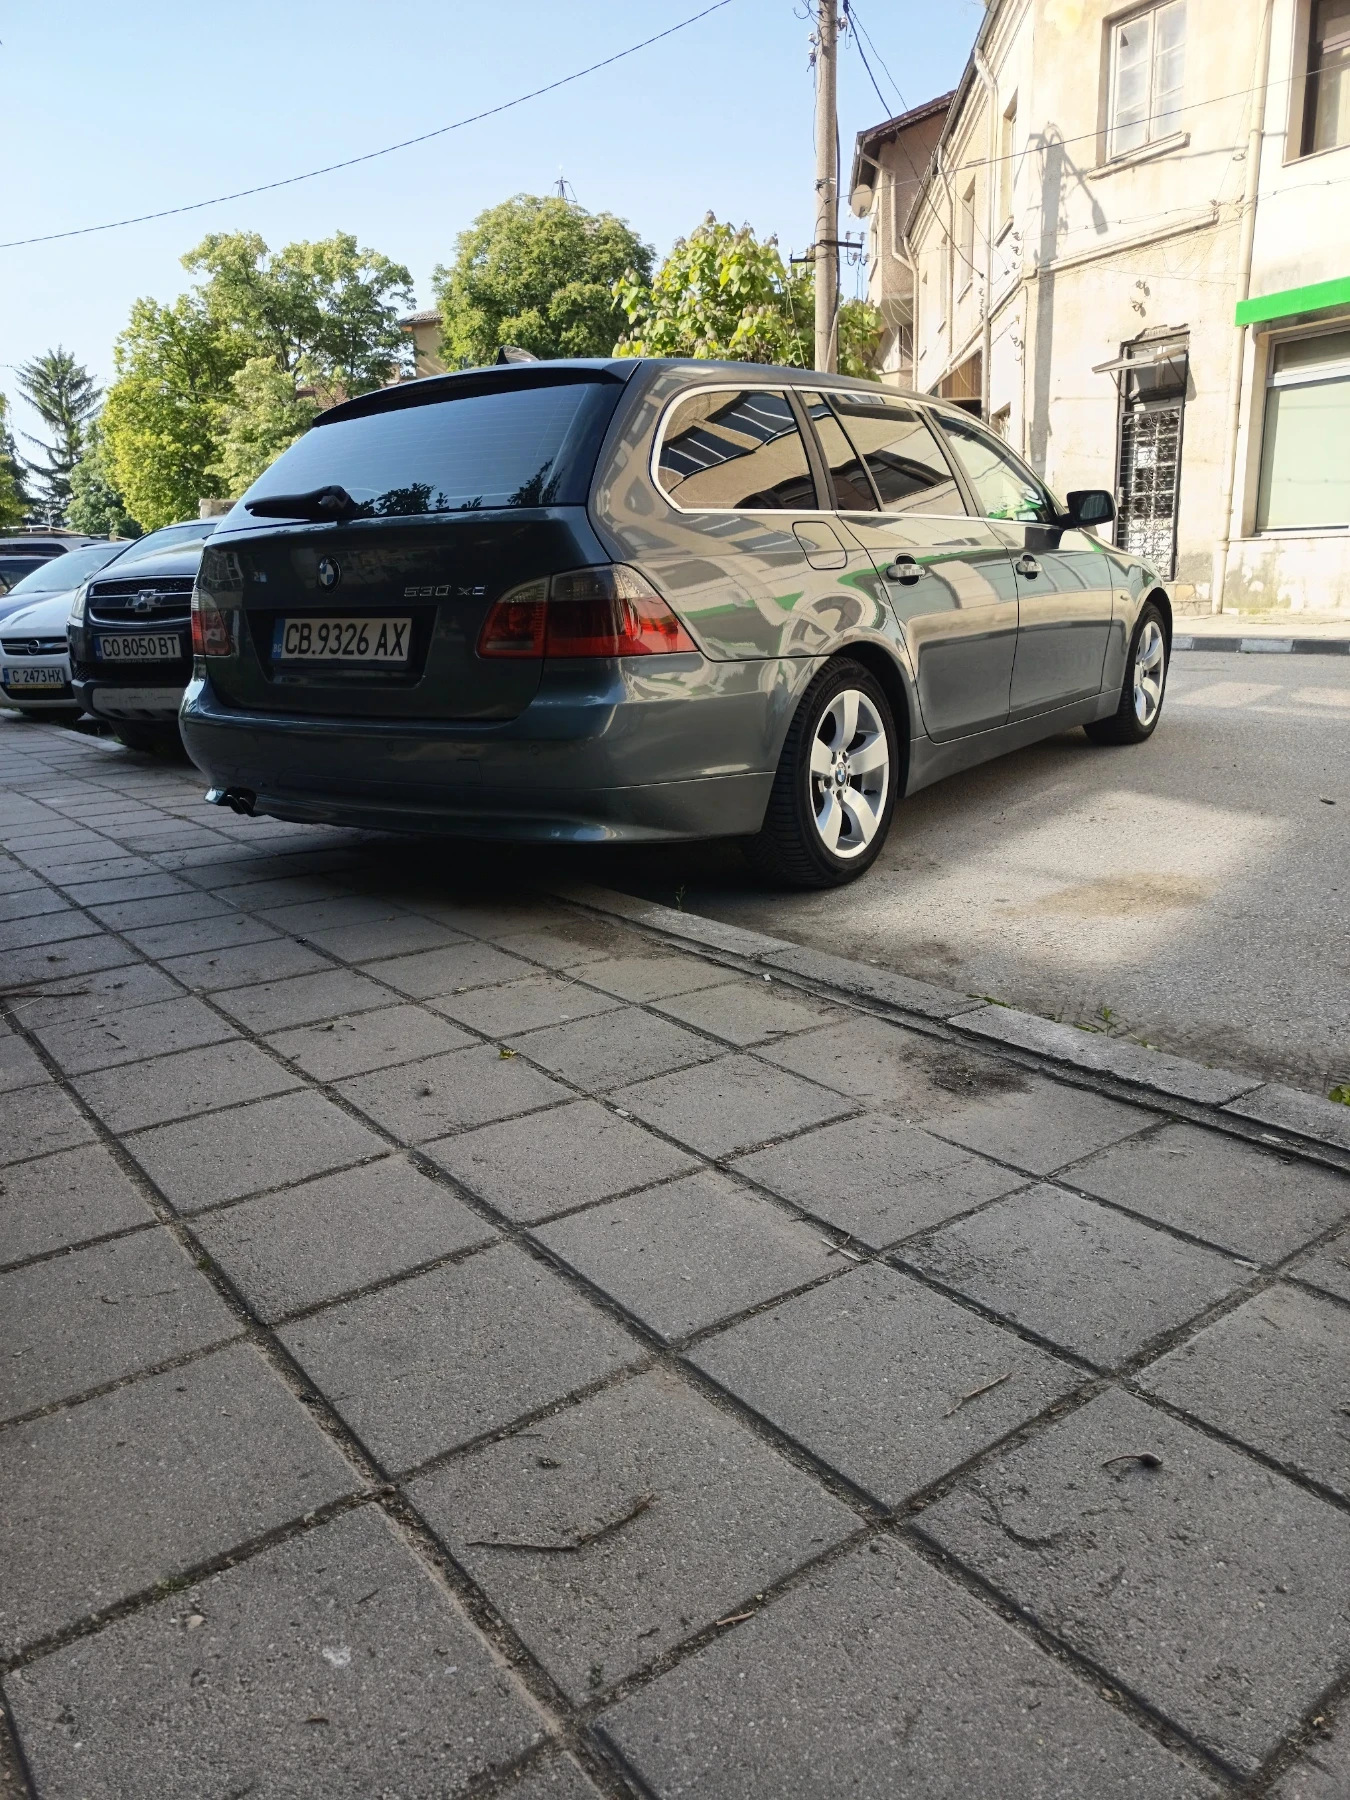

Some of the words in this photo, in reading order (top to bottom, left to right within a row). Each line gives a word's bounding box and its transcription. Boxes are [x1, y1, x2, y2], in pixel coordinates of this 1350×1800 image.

[403, 584, 452, 597] 530
[102, 638, 120, 657] CO
[122, 637, 156, 657] 8050
[158, 636, 177, 655] BT
[374, 623, 407, 656] AX
[273, 643, 282, 653] BG
[12, 669, 20, 683] C
[23, 669, 47, 683] 2473
[47, 669, 62, 683] HX
